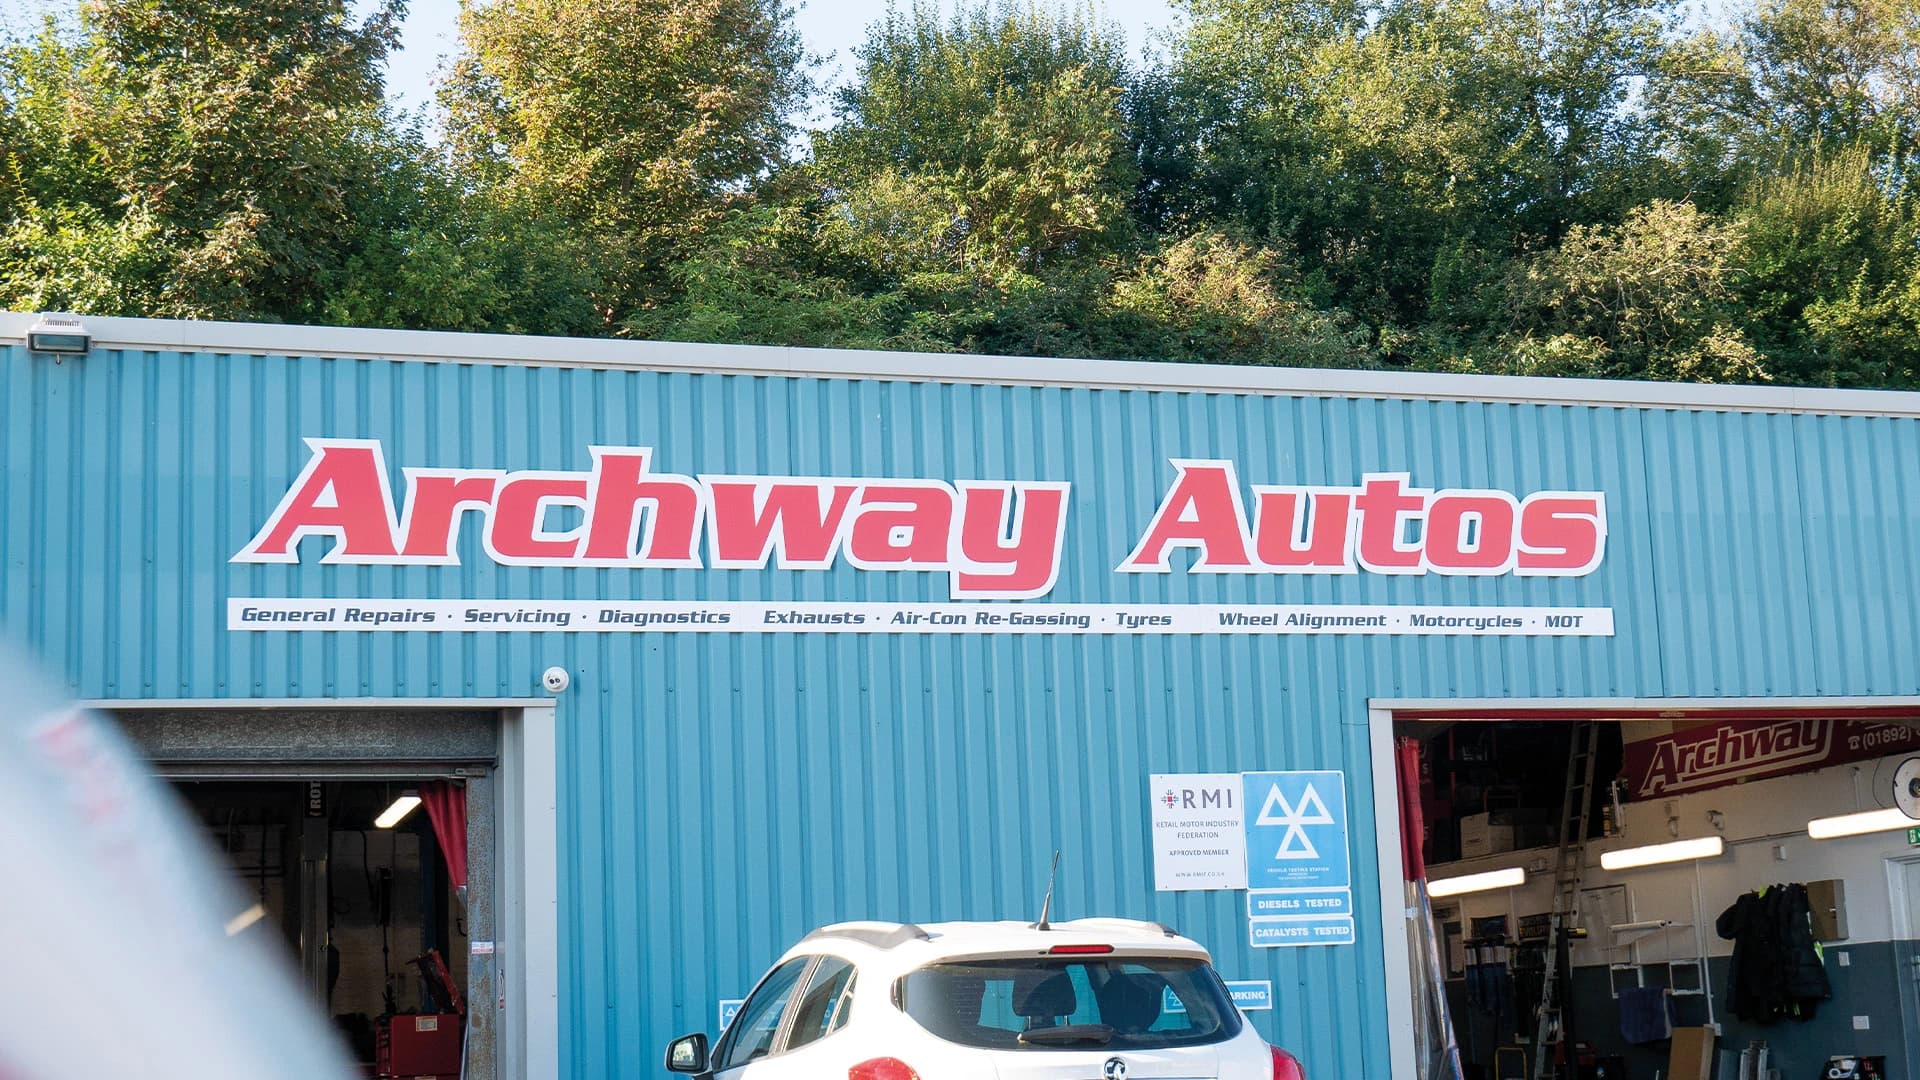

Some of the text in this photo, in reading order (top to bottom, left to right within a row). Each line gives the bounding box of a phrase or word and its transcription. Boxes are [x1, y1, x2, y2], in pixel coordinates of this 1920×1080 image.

[232, 438, 1606, 598] Archway Autos
[241, 607, 1584, 630] General Repairs Servicing Diagnostics Exhausts Air-Con Re-Gassing Tyres Wheel Alignment Motorcycles MOT
[1863, 726, 1911, 750] (01892)
[1639, 720, 1833, 797] Archway
[1182, 789, 1232, 809] RMI
[1156, 821, 1178, 829] RETAIL
[1205, 820, 1239, 828] INDUSTRY
[1177, 831, 1219, 839] FEDERATION
[1169, 848, 1229, 857] APPROVED MEMBER
[1258, 898, 1342, 909] DIESELS TESTED
[1255, 925, 1350, 937] CATALYSTS TESTED
[1229, 991, 1266, 1000] ARKING
